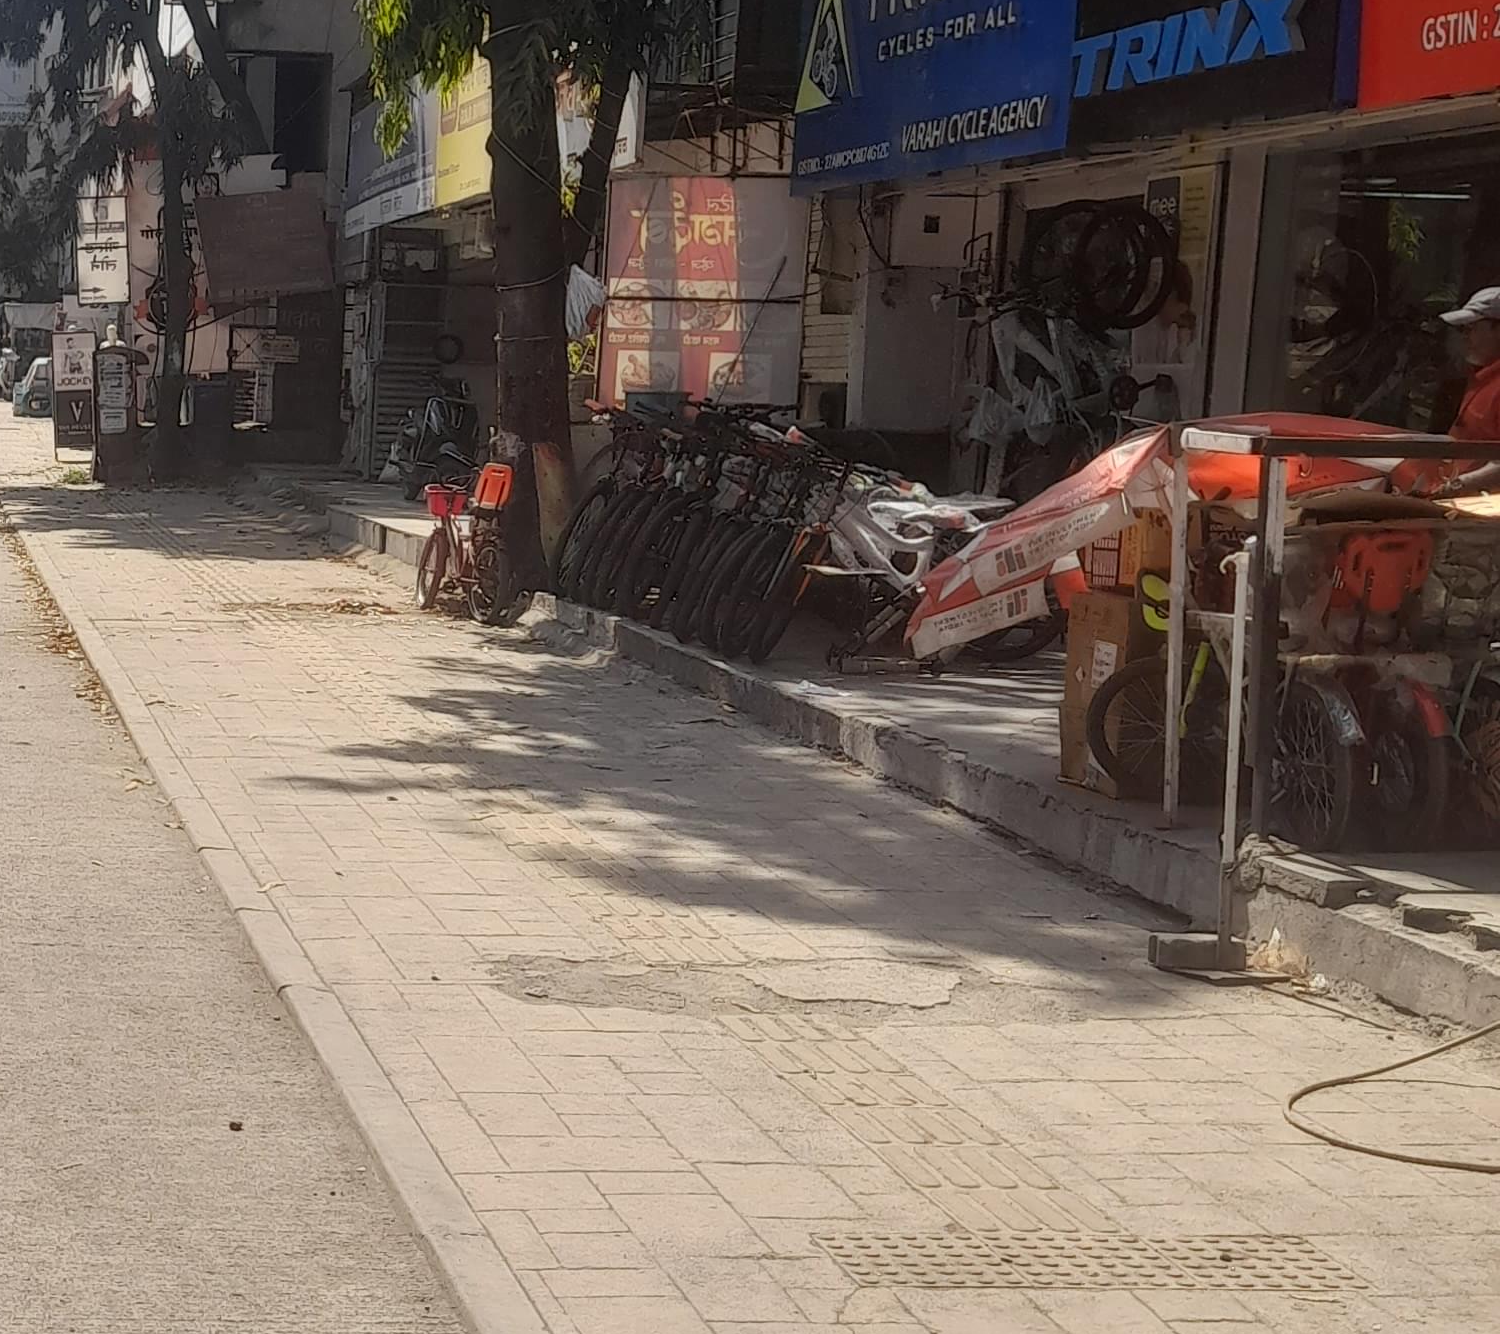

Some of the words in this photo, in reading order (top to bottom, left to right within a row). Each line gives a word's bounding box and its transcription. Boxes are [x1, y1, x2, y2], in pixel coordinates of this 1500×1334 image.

[877, 25, 935, 63] CYCLES
[944, 12, 976, 41] FOR
[984, 0, 1017, 28] ALL
[1422, 9, 1479, 52] GSTIN
[901, 120, 944, 154] VARAHI
[946, 110, 988, 146] CYCLE
[987, 94, 1049, 138] AGENCY
